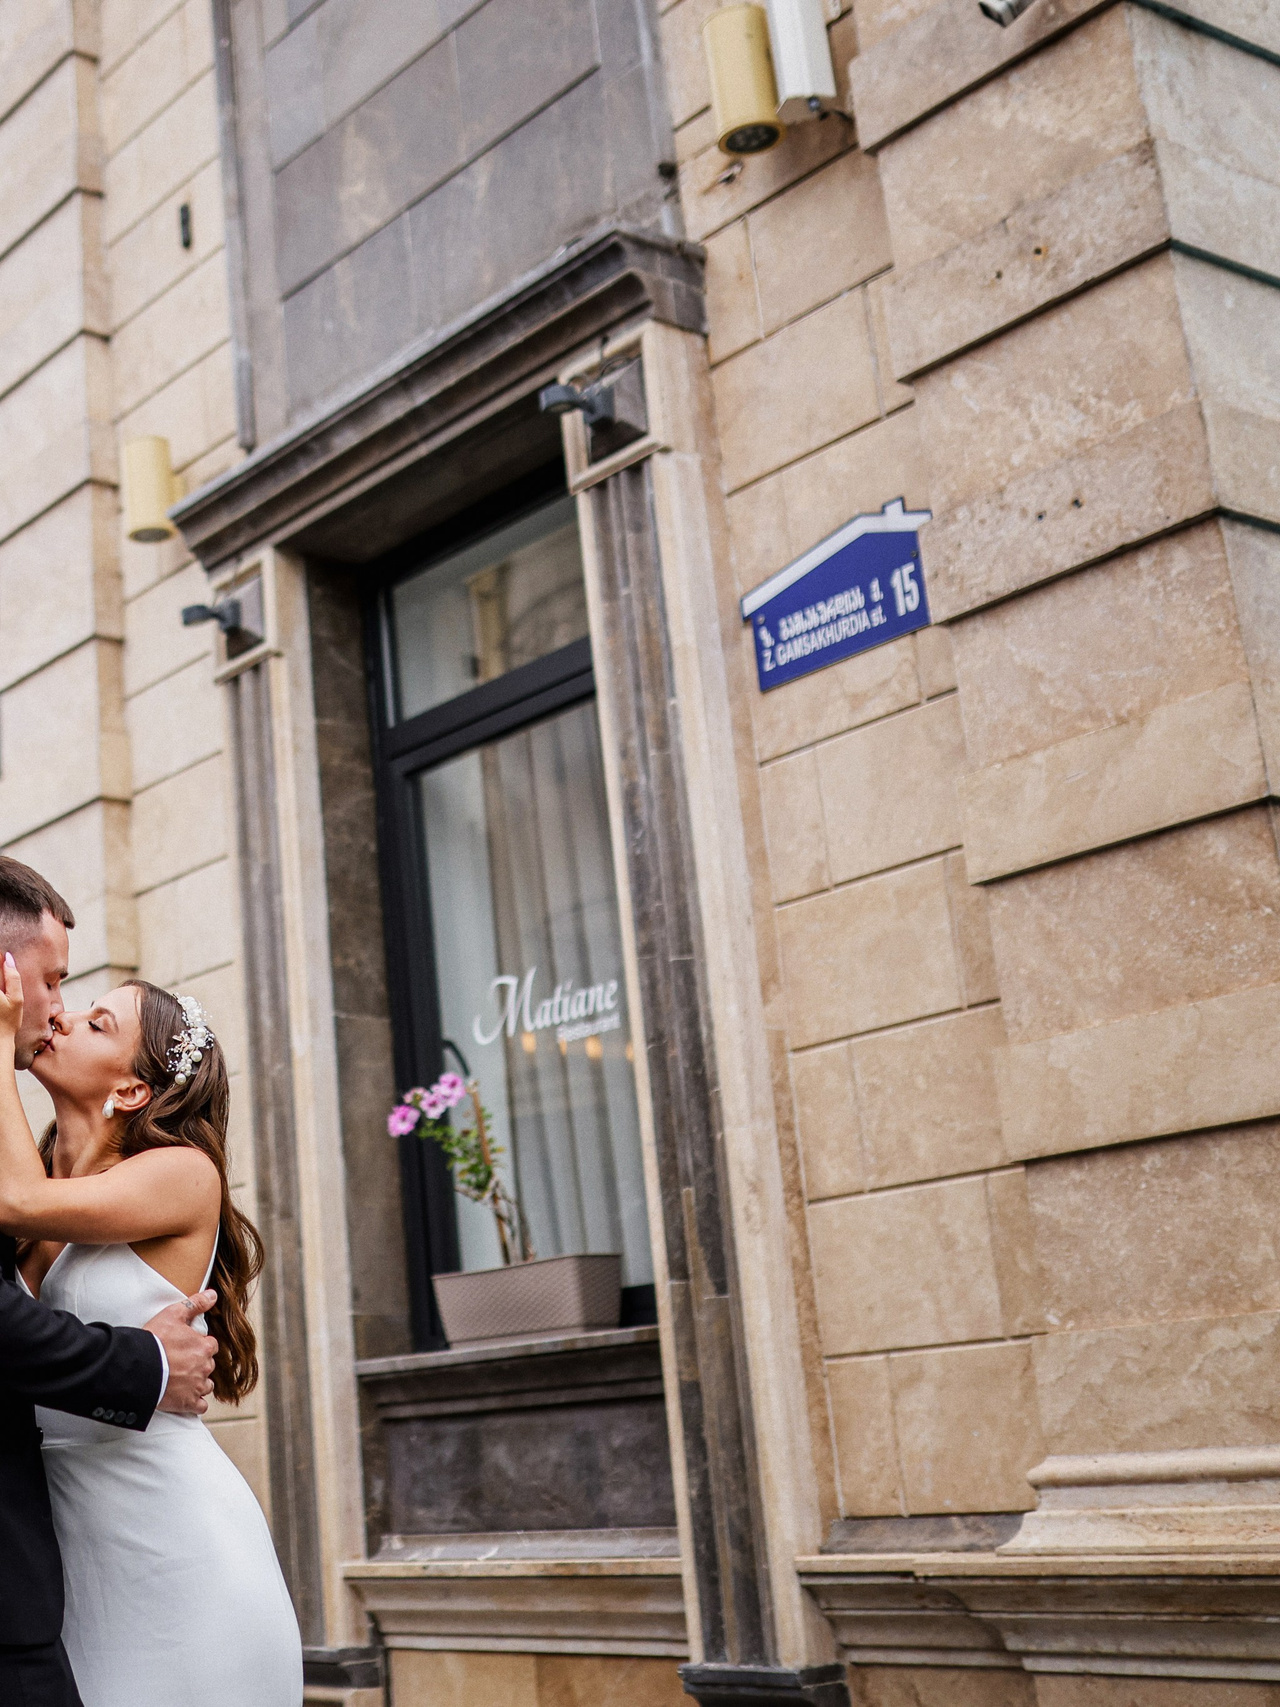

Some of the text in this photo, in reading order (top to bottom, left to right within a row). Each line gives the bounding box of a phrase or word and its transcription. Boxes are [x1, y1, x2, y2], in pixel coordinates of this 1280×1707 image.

[890, 562, 919, 616] 15
[775, 608, 871, 666] GAMSAKHURDIA
[471, 965, 619, 1045] Matiane
